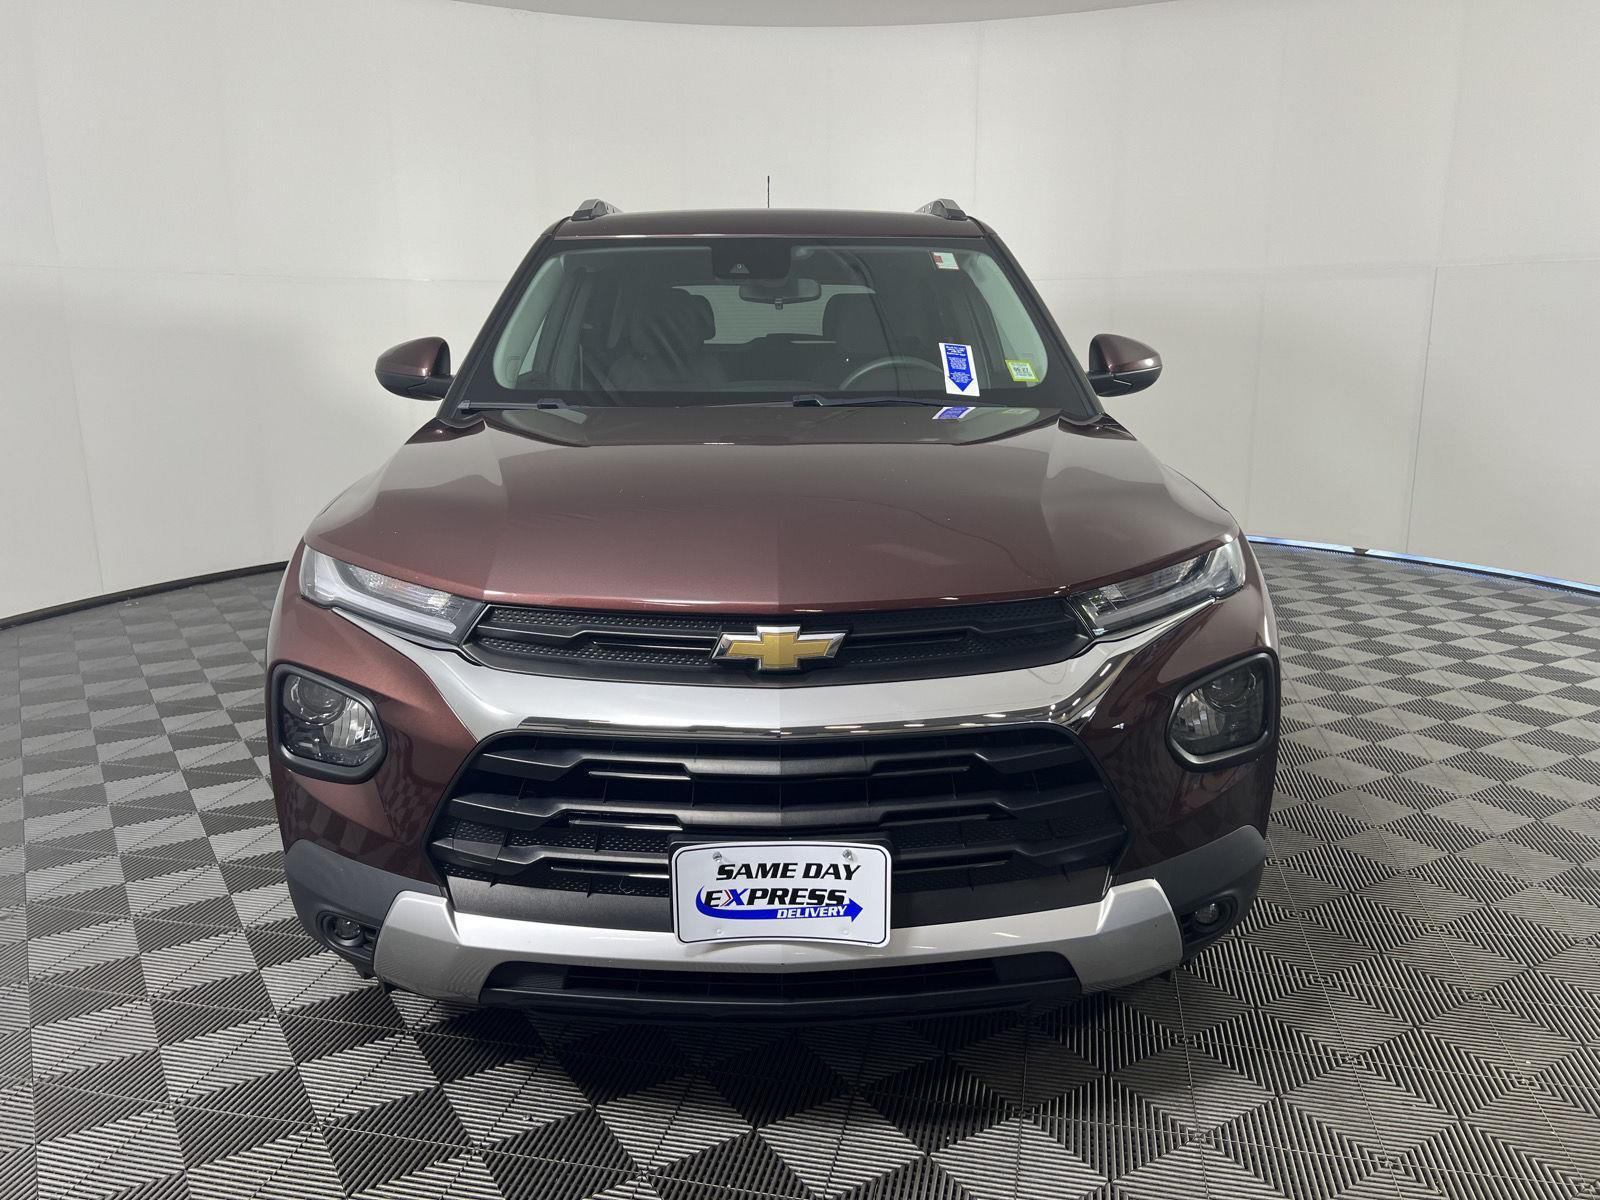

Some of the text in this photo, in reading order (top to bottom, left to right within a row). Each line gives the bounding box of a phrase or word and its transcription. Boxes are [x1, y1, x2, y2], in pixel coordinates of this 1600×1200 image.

[716, 863, 861, 880] SAME DAY
[704, 888, 847, 907] EXPRESS
[776, 906, 848, 919] DELIVERY
